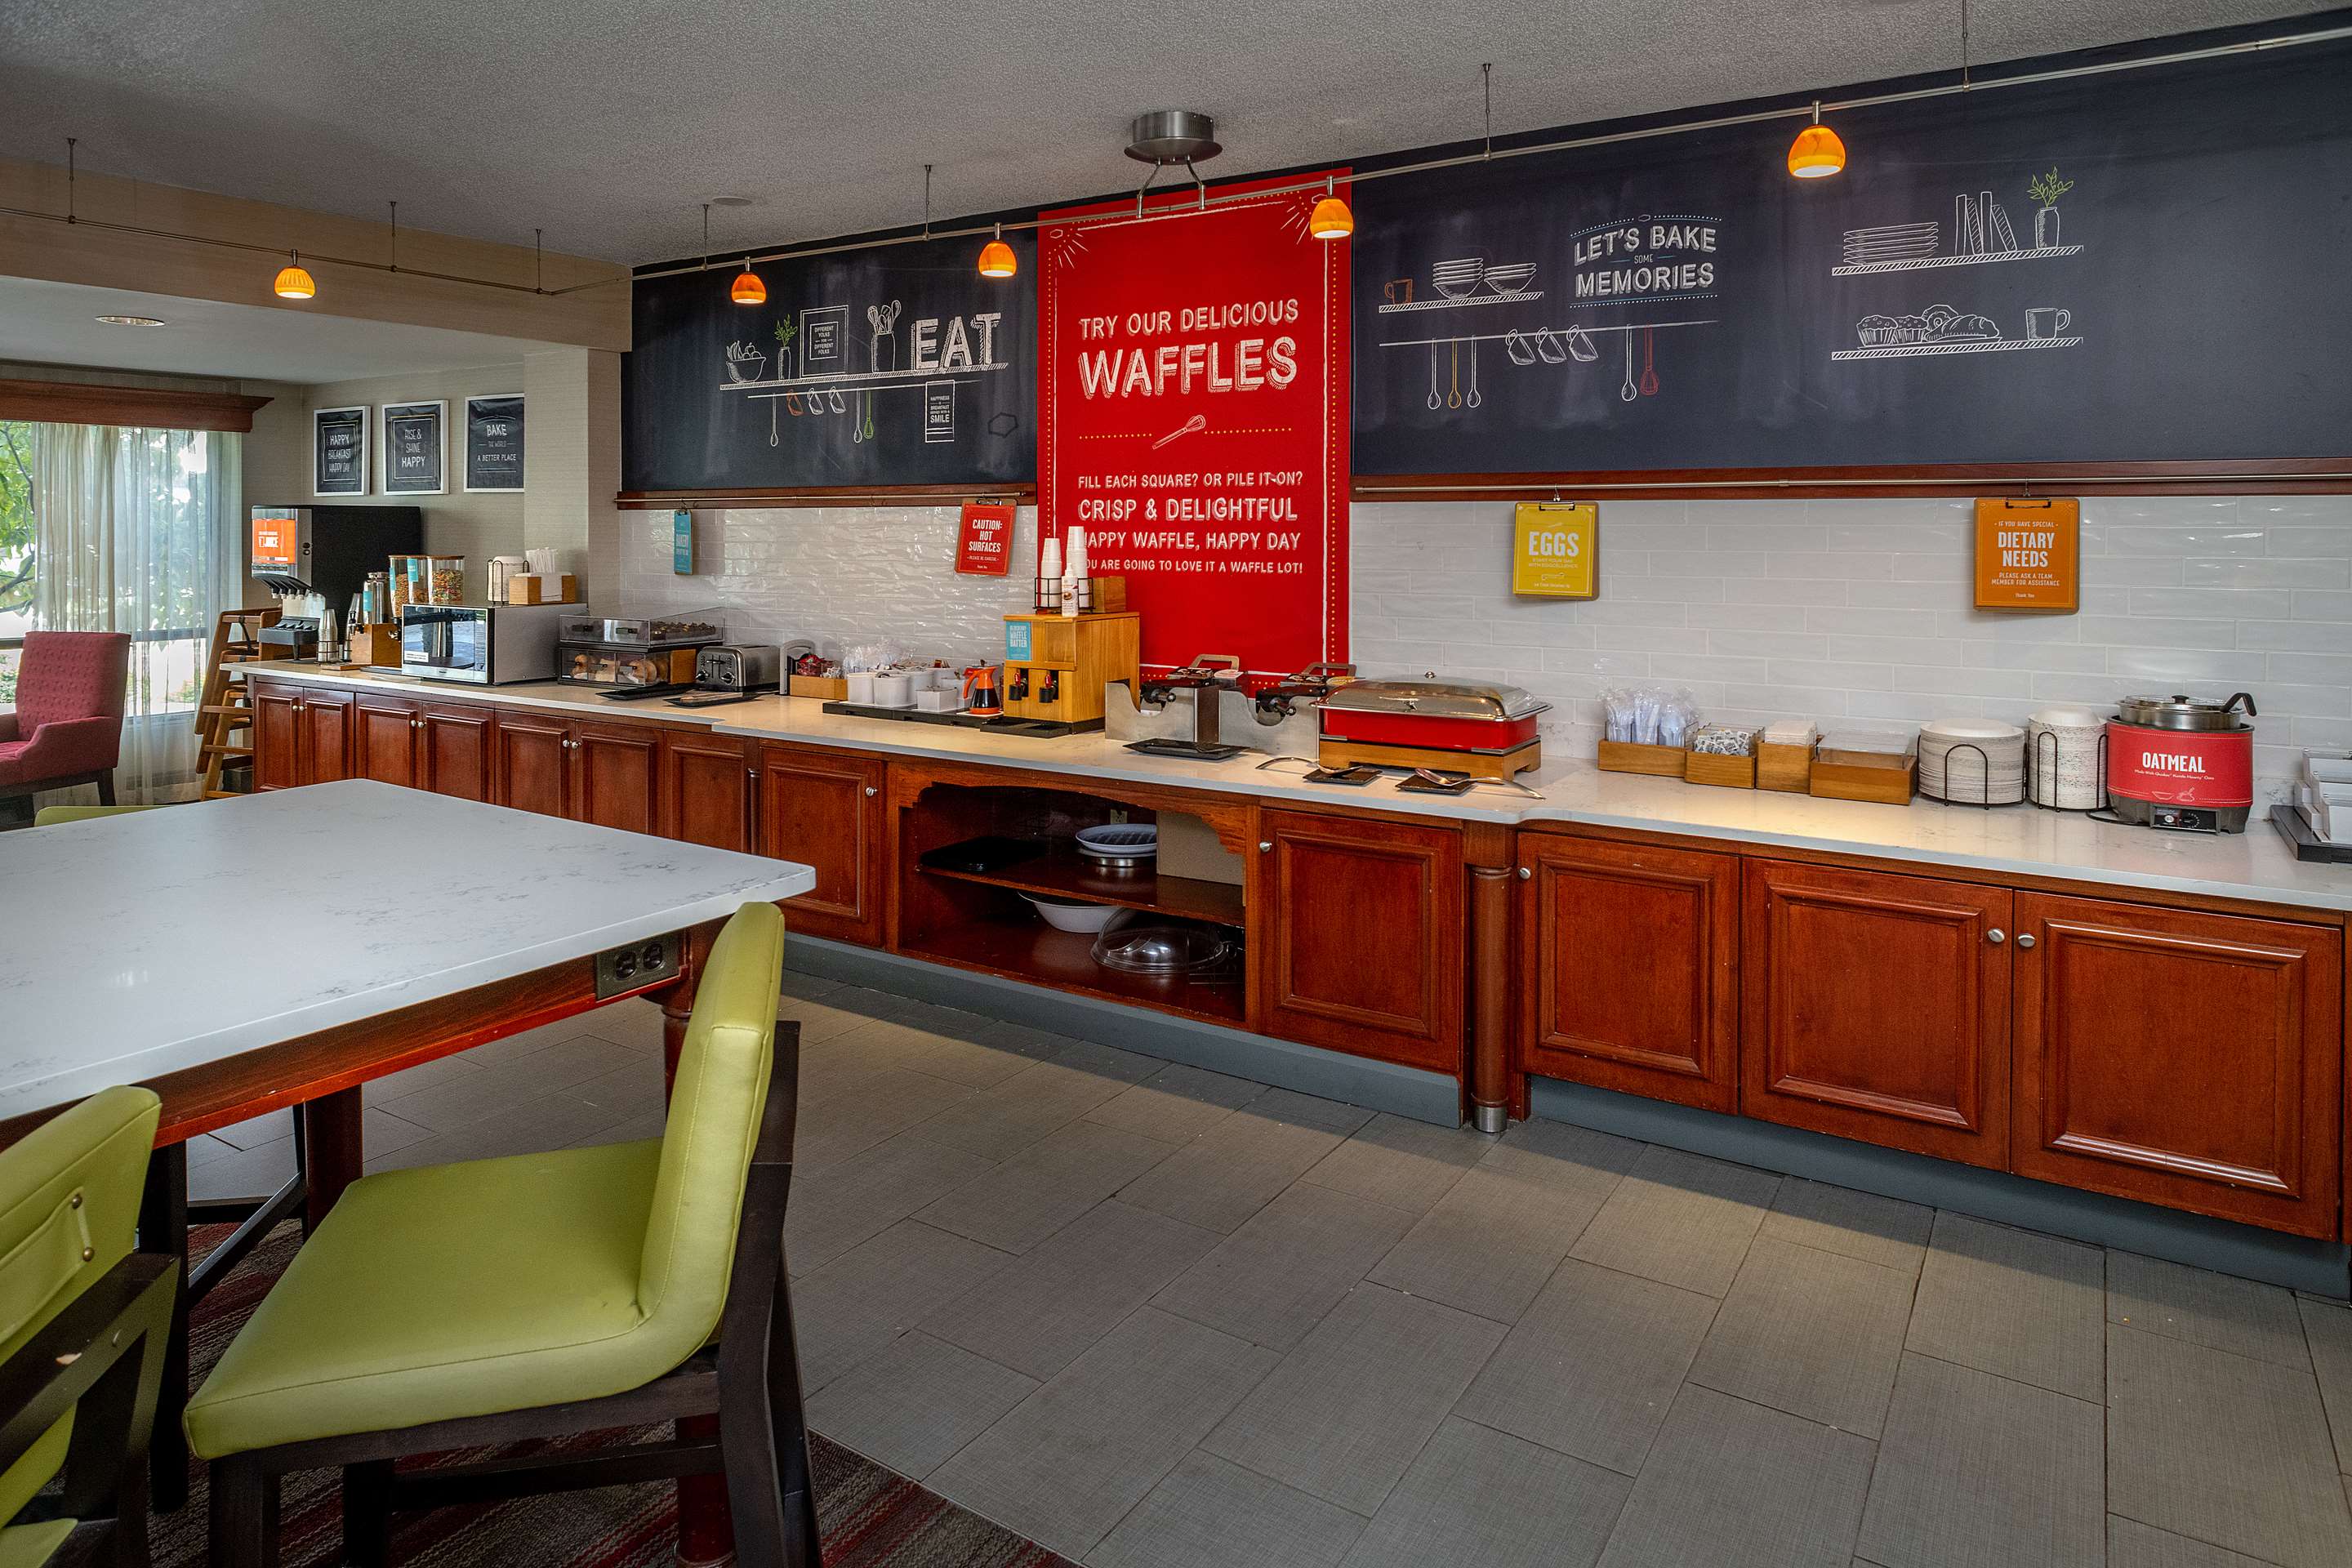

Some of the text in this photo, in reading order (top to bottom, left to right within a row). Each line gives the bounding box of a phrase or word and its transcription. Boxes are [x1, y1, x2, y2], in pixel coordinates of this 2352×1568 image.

[1574, 225, 1717, 266] LET'S BAKE
[1634, 254, 1654, 264] SOME
[1575, 262, 1714, 297] MEMORIES
[1079, 299, 1298, 340] TRY OUR DELICIOUS
[911, 313, 1001, 370] EAT
[1078, 336, 1297, 399] WAFFLES
[930, 414, 950, 423] SMILE
[416, 428, 423, 439] &
[486, 424, 507, 437] BAKE
[329, 434, 350, 446] HAPPY
[401, 456, 425, 468] HAPPY
[477, 454, 481, 462] A
[501, 453, 517, 461] PLACE
[1078, 475, 1101, 489] FILL
[1106, 474, 1137, 488] EACH
[1141, 473, 1199, 488] SQUARE?
[1204, 472, 1222, 487] OR
[1227, 472, 1254, 487] PILE
[1078, 497, 1298, 522] CRISP & DELIGHTFUL
[972, 519, 1003, 530] CAUTION:
[979, 531, 993, 541] HOT
[1085, 531, 1301, 551] APPY WAFFLE, HAPPY DAY
[1529, 531, 1579, 557] EGGS
[1998, 532, 2055, 549] DIETARY
[969, 541, 1001, 553] SURFACES
[1100, 559, 1120, 570] ARE
[1124, 559, 1155, 571] GOING
[1159, 560, 1172, 571] TO
[1176, 559, 1203, 572] LOVE
[1205, 560, 1215, 572] IT
[1219, 561, 1227, 572] A
[1231, 561, 1274, 573] WAFFLE
[1278, 562, 1303, 574] LOT!
[2002, 550, 2048, 568] NEEDS
[2142, 751, 2206, 773] OATMEAL
